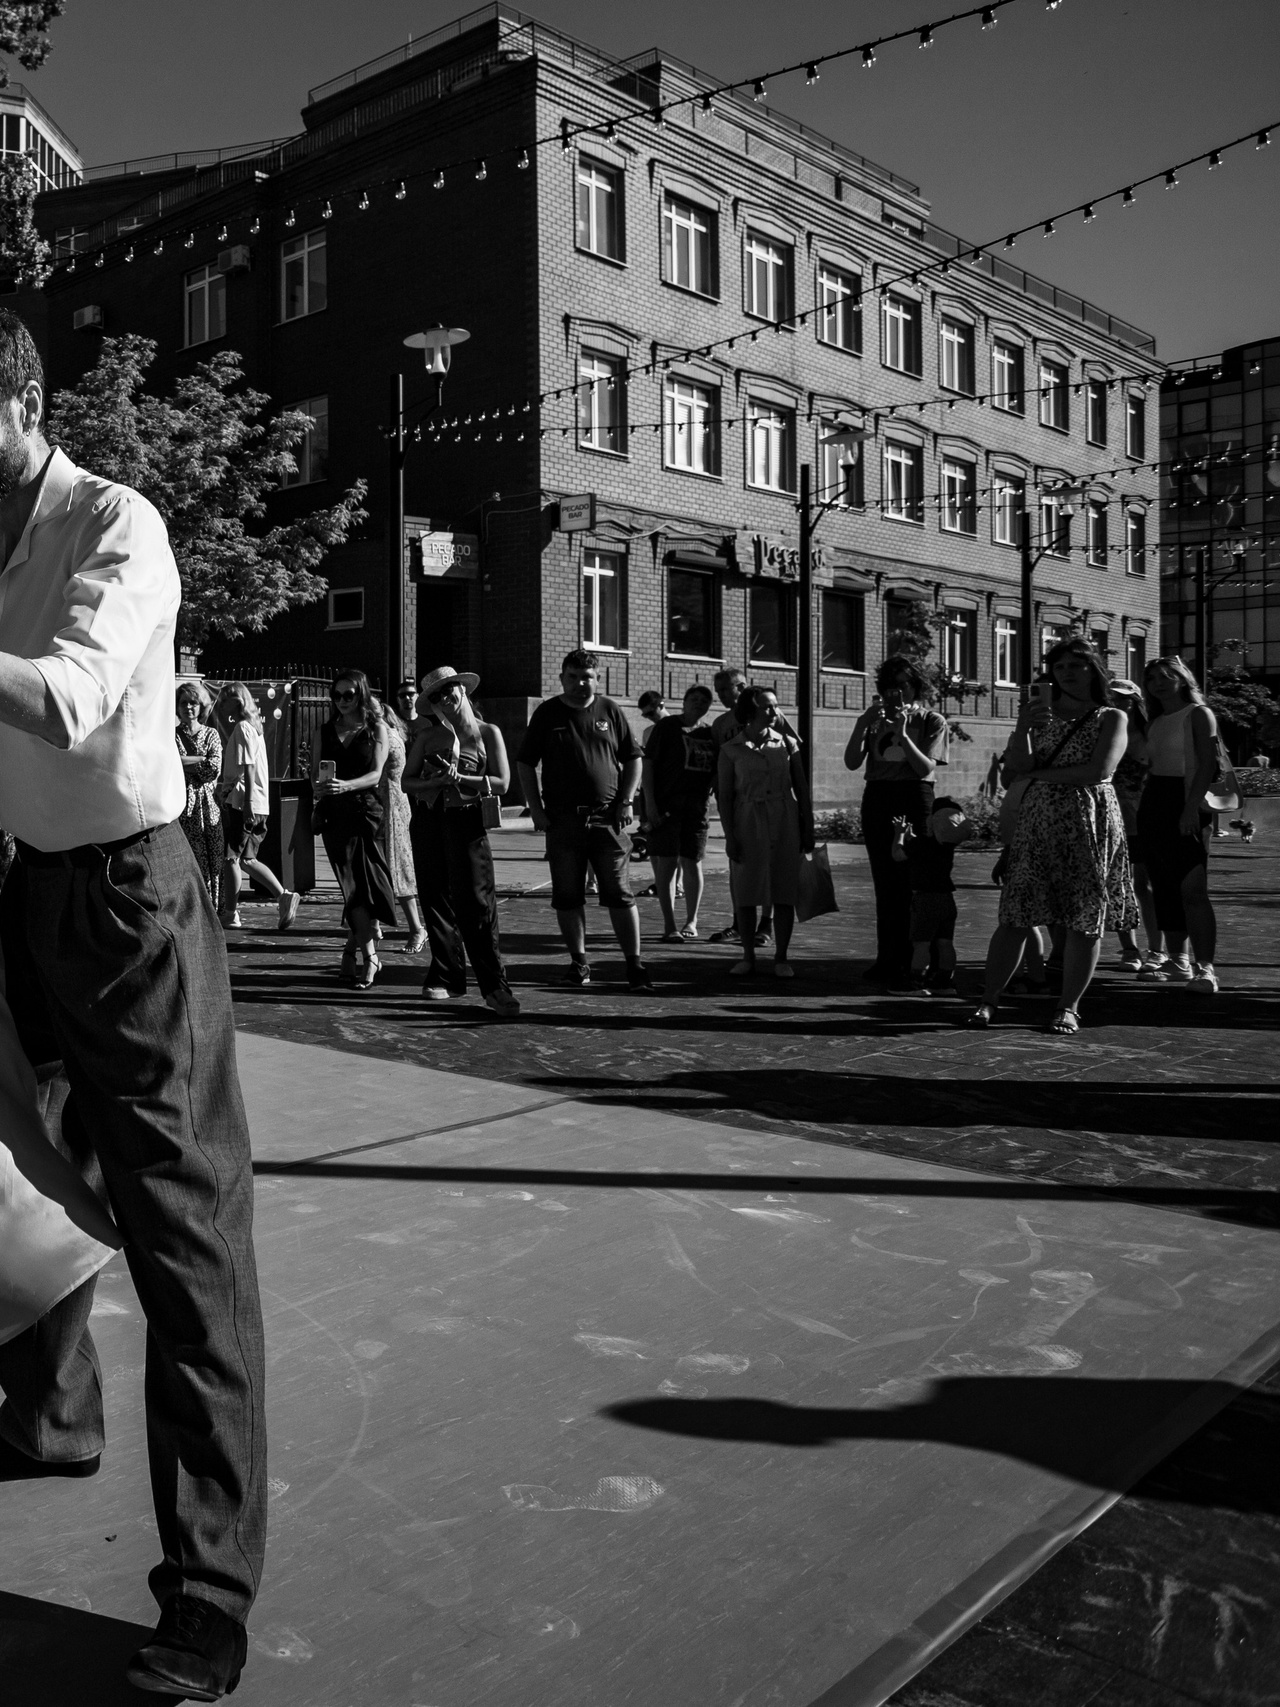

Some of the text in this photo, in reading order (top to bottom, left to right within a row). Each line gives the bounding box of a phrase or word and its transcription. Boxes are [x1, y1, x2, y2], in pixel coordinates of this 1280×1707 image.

[562, 503, 589, 512] PECADO
[568, 511, 583, 519] BAR
[431, 542, 471, 556] PECADO
[754, 534, 825, 574] Pecao
[442, 554, 462, 567] BAR
